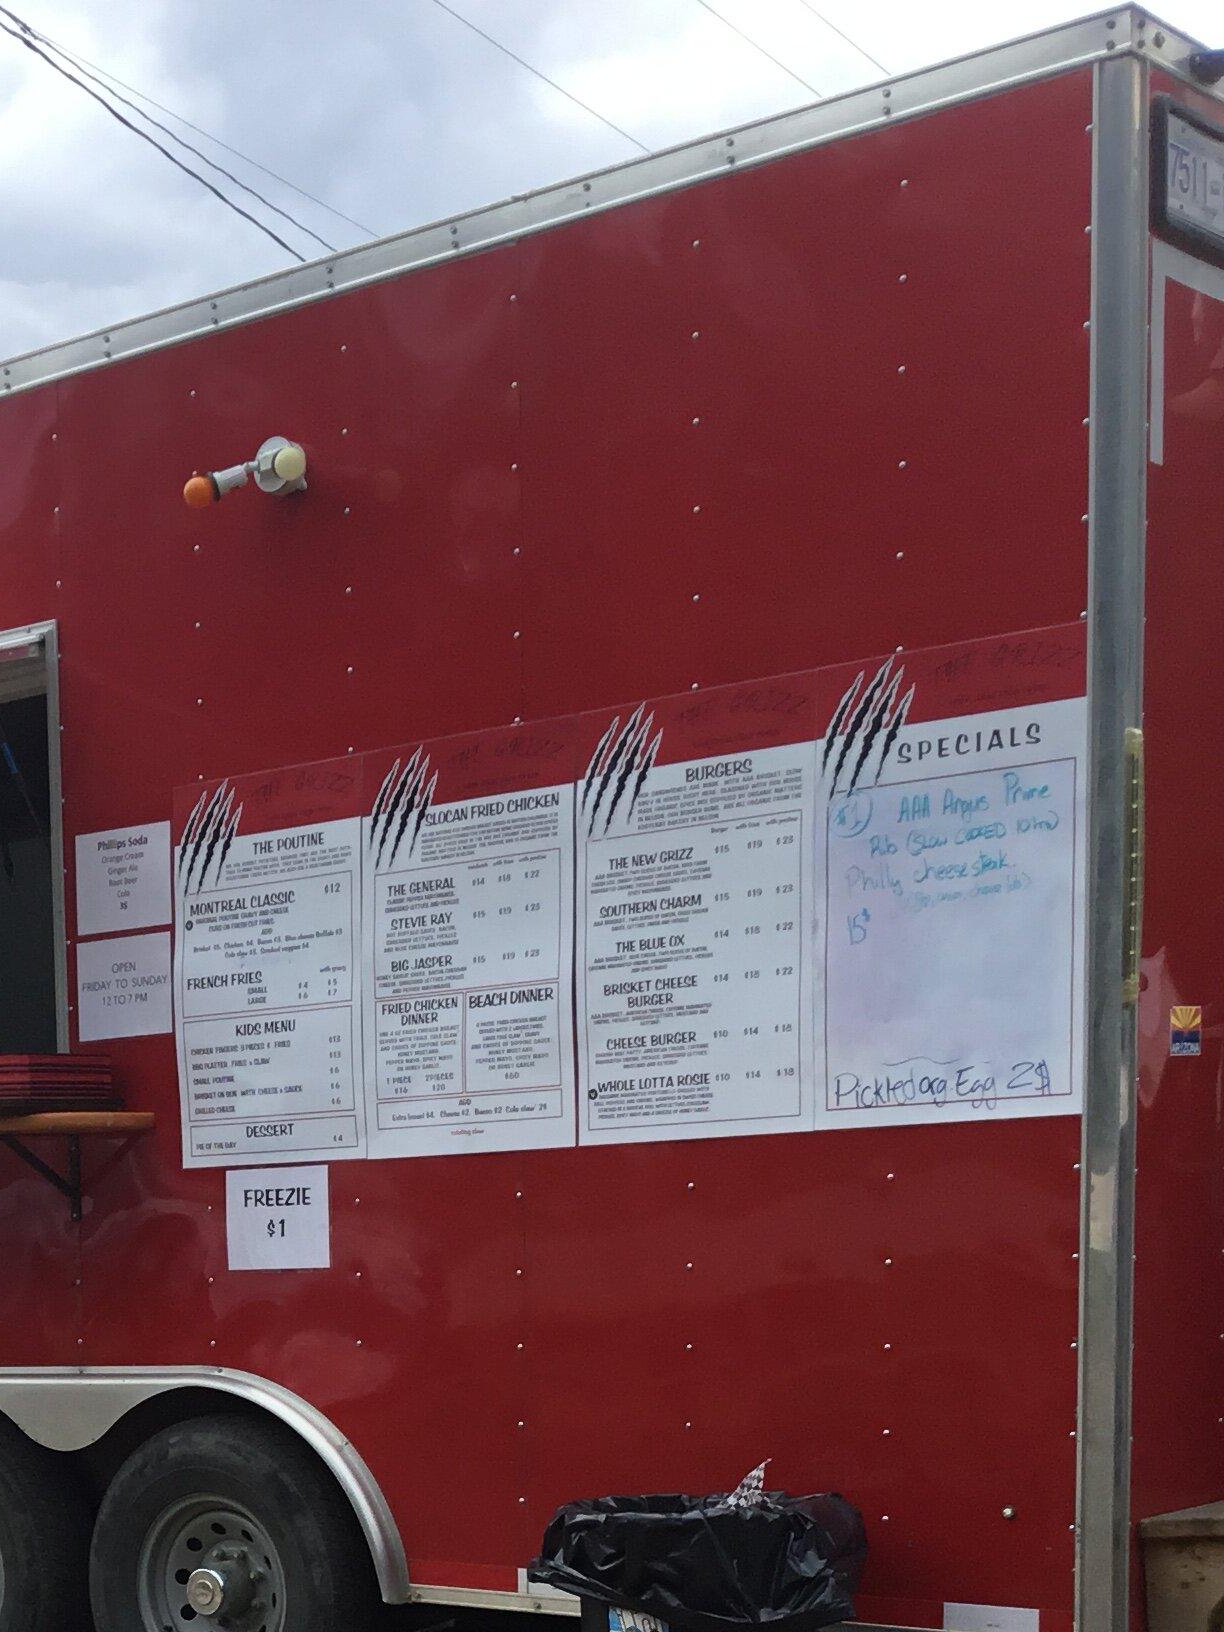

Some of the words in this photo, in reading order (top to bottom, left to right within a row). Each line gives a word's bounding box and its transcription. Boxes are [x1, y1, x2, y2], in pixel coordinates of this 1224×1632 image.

[897, 722, 1042, 765] SPECIALS
[685, 758, 753, 783] BURGERS
[425, 806, 469, 827] SLOCAN
[471, 801, 504, 819] FRIED
[506, 792, 560, 812] CHICKEN
[253, 839, 274, 855] THE
[277, 831, 325, 852] POUTINE
[609, 856, 629, 870] THE
[632, 852, 658, 867] NEW
[659, 847, 694, 863] GRIZZ
[387, 883, 406, 898] THE
[409, 877, 456, 895] GENERAL
[189, 897, 248, 917] MONTREAL
[250, 890, 296, 909] CLASSIC
[599, 900, 658, 919] SOUTHERN
[659, 894, 702, 911] CHARM
[390, 915, 427, 931] STEVIE
[430, 912, 453, 926] RAY
[616, 939, 636, 954] THE
[639, 936, 666, 952] BLUE
[668, 934, 685, 948] OX
[111, 961, 136, 974] OPEN
[390, 958, 409, 973] BIG
[411, 954, 453, 971] JASPER
[82, 979, 111, 992] FRIDAY
[115, 978, 128, 989] TO
[131, 974, 168, 988] SUNDAY
[187, 973, 227, 991] FRENCH
[231, 971, 263, 985] FRIES
[603, 979, 651, 997] BRISKET
[655, 975, 698, 991] CHEESE
[113, 994, 126, 1006] TO
[134, 992, 148, 1003] PM
[381, 1002, 412, 1015] FRIED
[413, 996, 458, 1013] CHICKEN
[468, 991, 507, 1009] BEACH
[510, 987, 554, 1005] DINNER
[627, 993, 674, 1009] BURGER
[235, 1022, 262, 1037] KIDS
[264, 1019, 296, 1034] MENU
[400, 1011, 439, 1027] DINNER
[606, 1035, 647, 1051] CHEESE
[650, 1031, 697, 1048] BURGER
[597, 1078, 636, 1093] WHOLE
[638, 1075, 675, 1091] LOTTA
[676, 1072, 711, 1087] ROSIE
[246, 1123, 295, 1139] DESSERT
[243, 1187, 312, 1208] FREEZIE
[267, 1218, 285, 1238] $1
